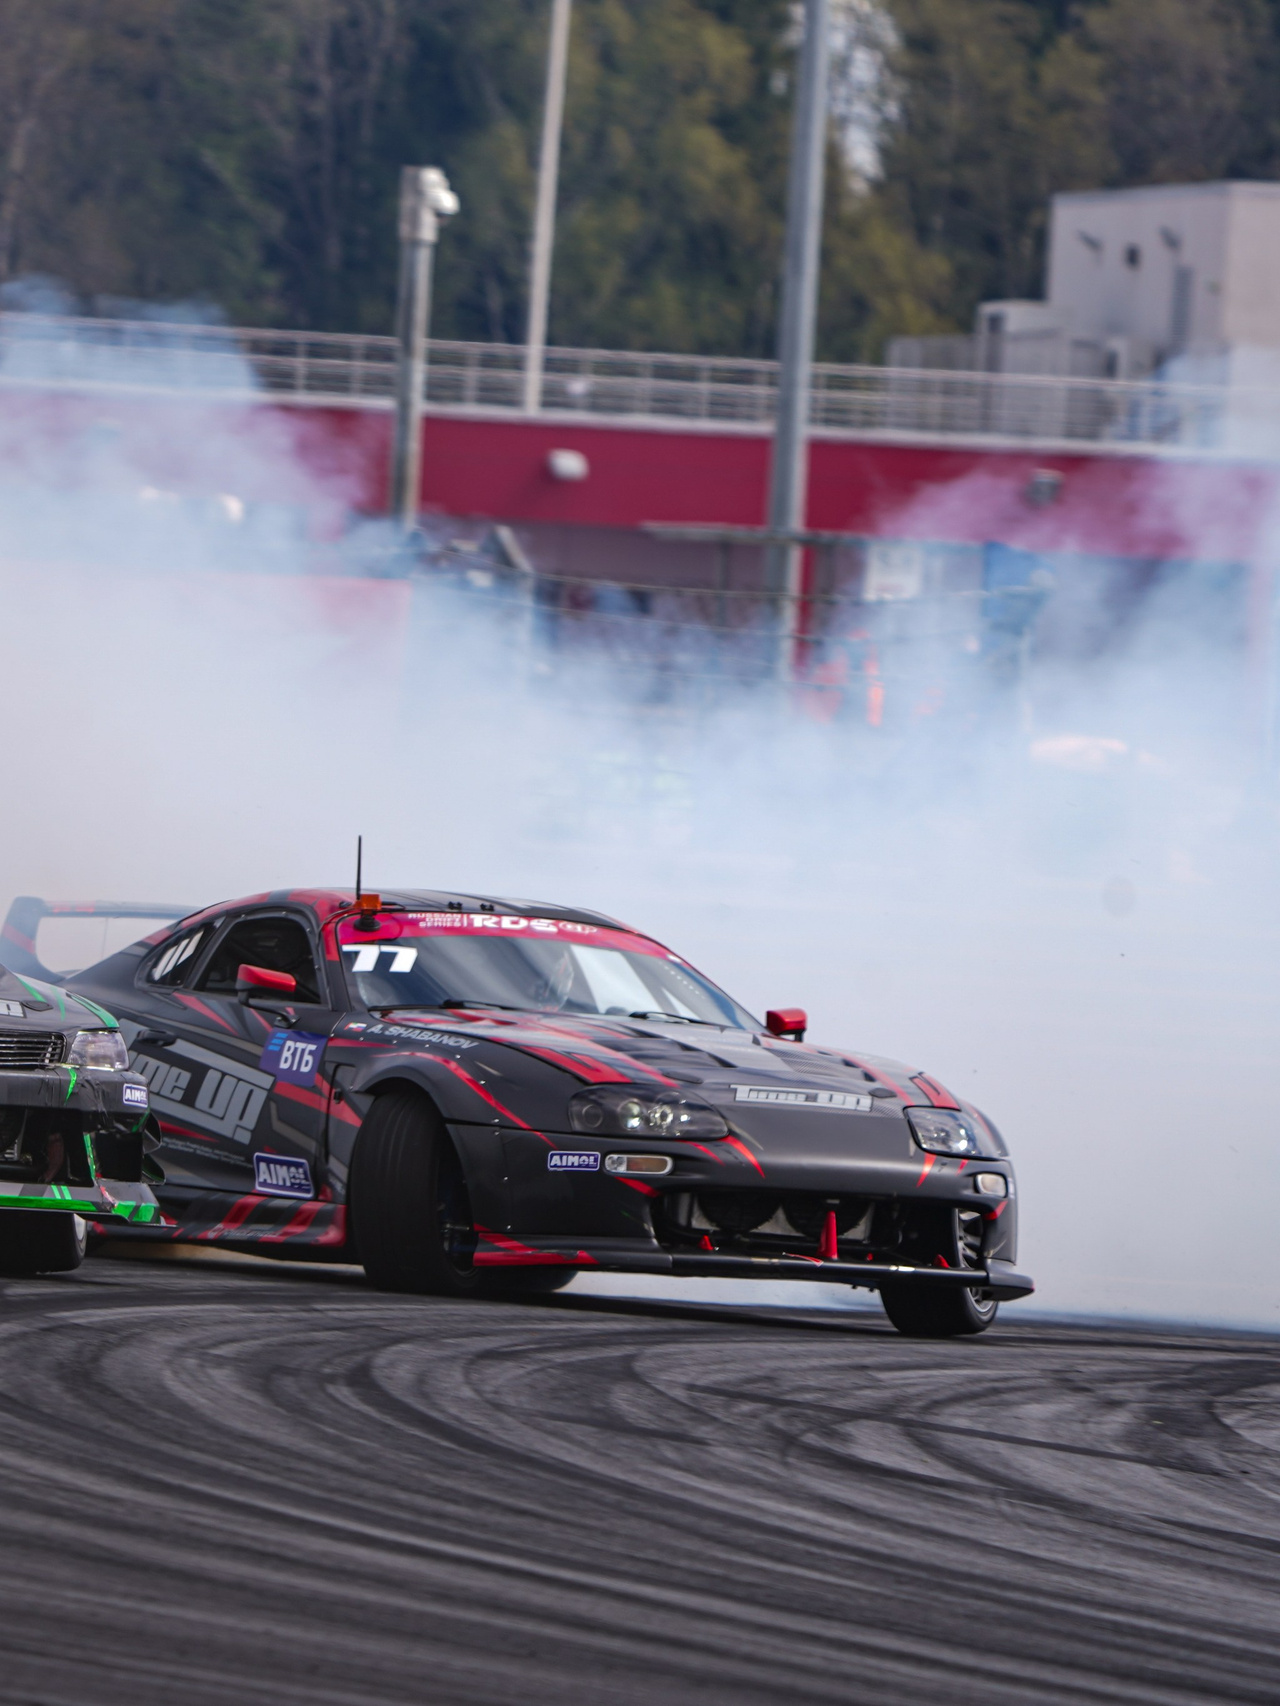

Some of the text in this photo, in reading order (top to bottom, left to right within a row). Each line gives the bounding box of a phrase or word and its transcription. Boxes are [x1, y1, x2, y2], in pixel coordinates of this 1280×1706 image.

[470, 913, 559, 934] RDS
[342, 944, 418, 973] 77
[367, 1023, 479, 1049] A. SHABANOV
[550, 1154, 598, 1167] AIMOL
[258, 1160, 311, 1188] AIMOL
